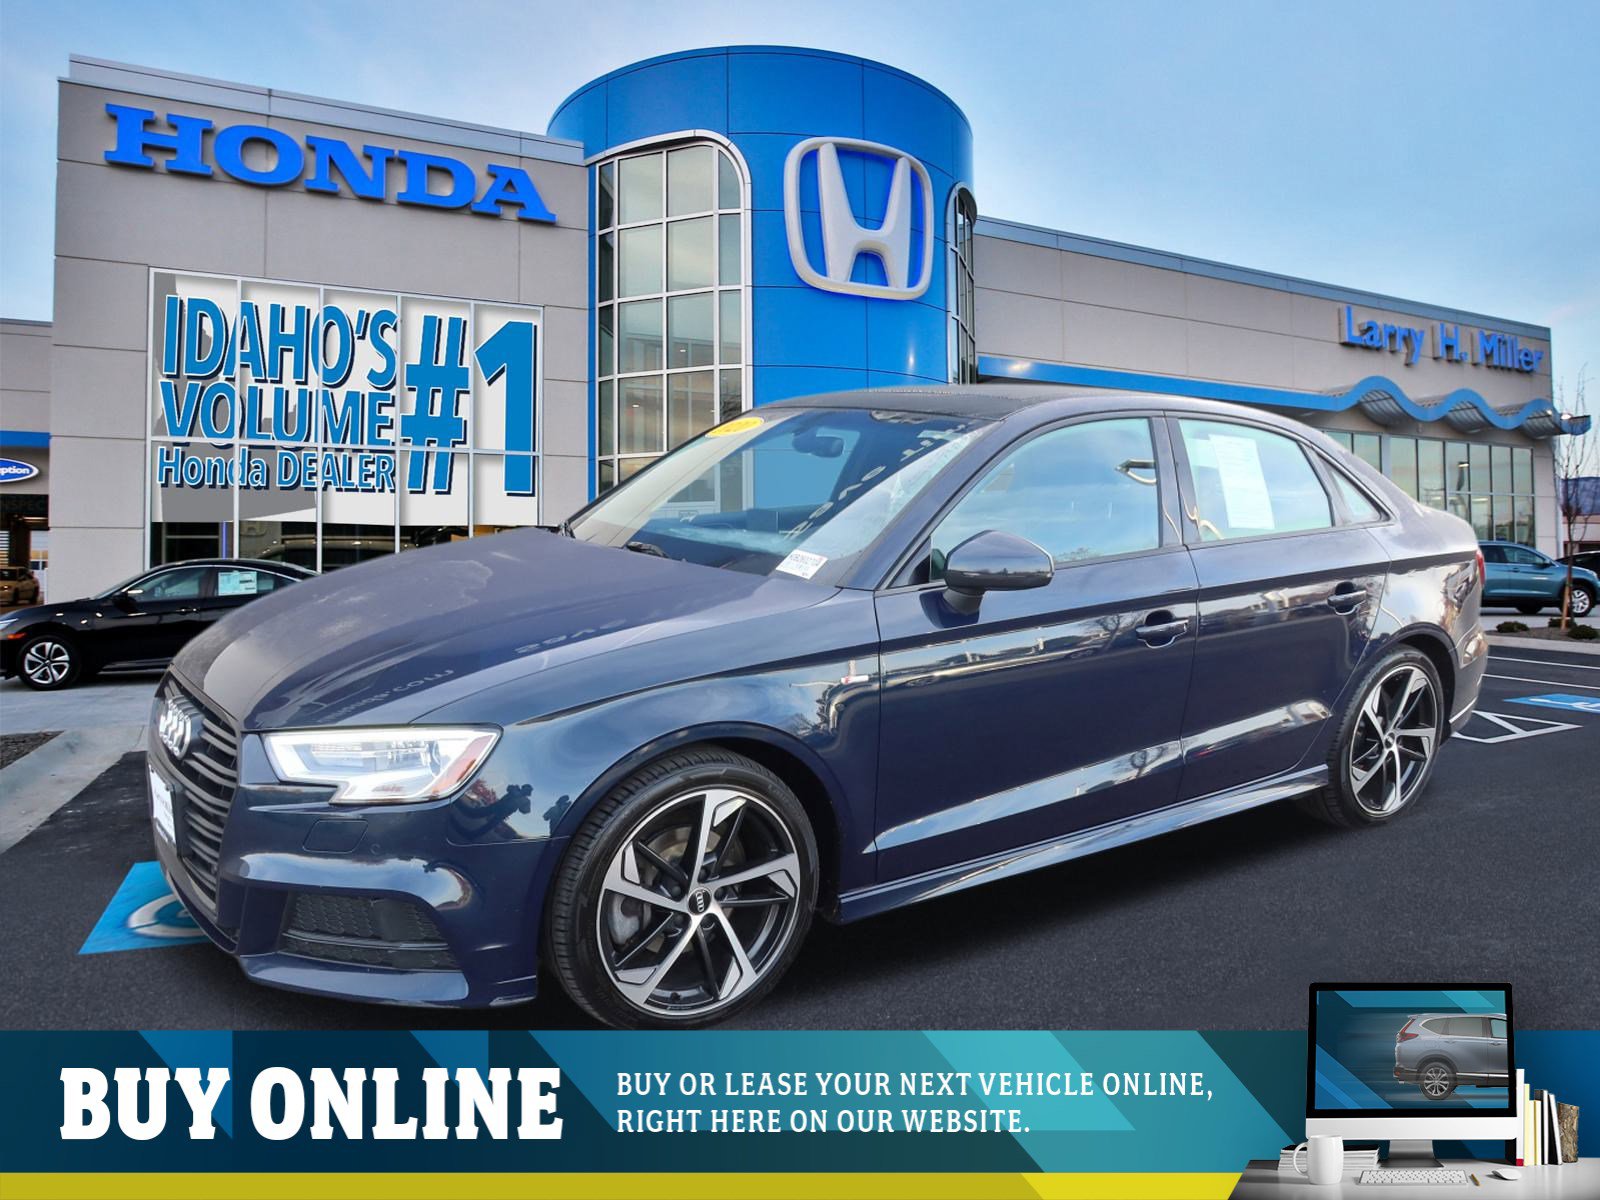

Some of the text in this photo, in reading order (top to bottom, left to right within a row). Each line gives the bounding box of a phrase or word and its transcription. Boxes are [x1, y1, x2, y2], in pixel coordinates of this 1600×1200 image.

[105, 103, 557, 224] HONDA
[163, 295, 398, 390] IDAHO'S
[1341, 305, 1544, 373] Larry H. Miller
[159, 381, 397, 453] VOLUME
[400, 314, 537, 496] #1
[0, 466, 30, 476] ption
[157, 446, 396, 494] Honda DEALER
